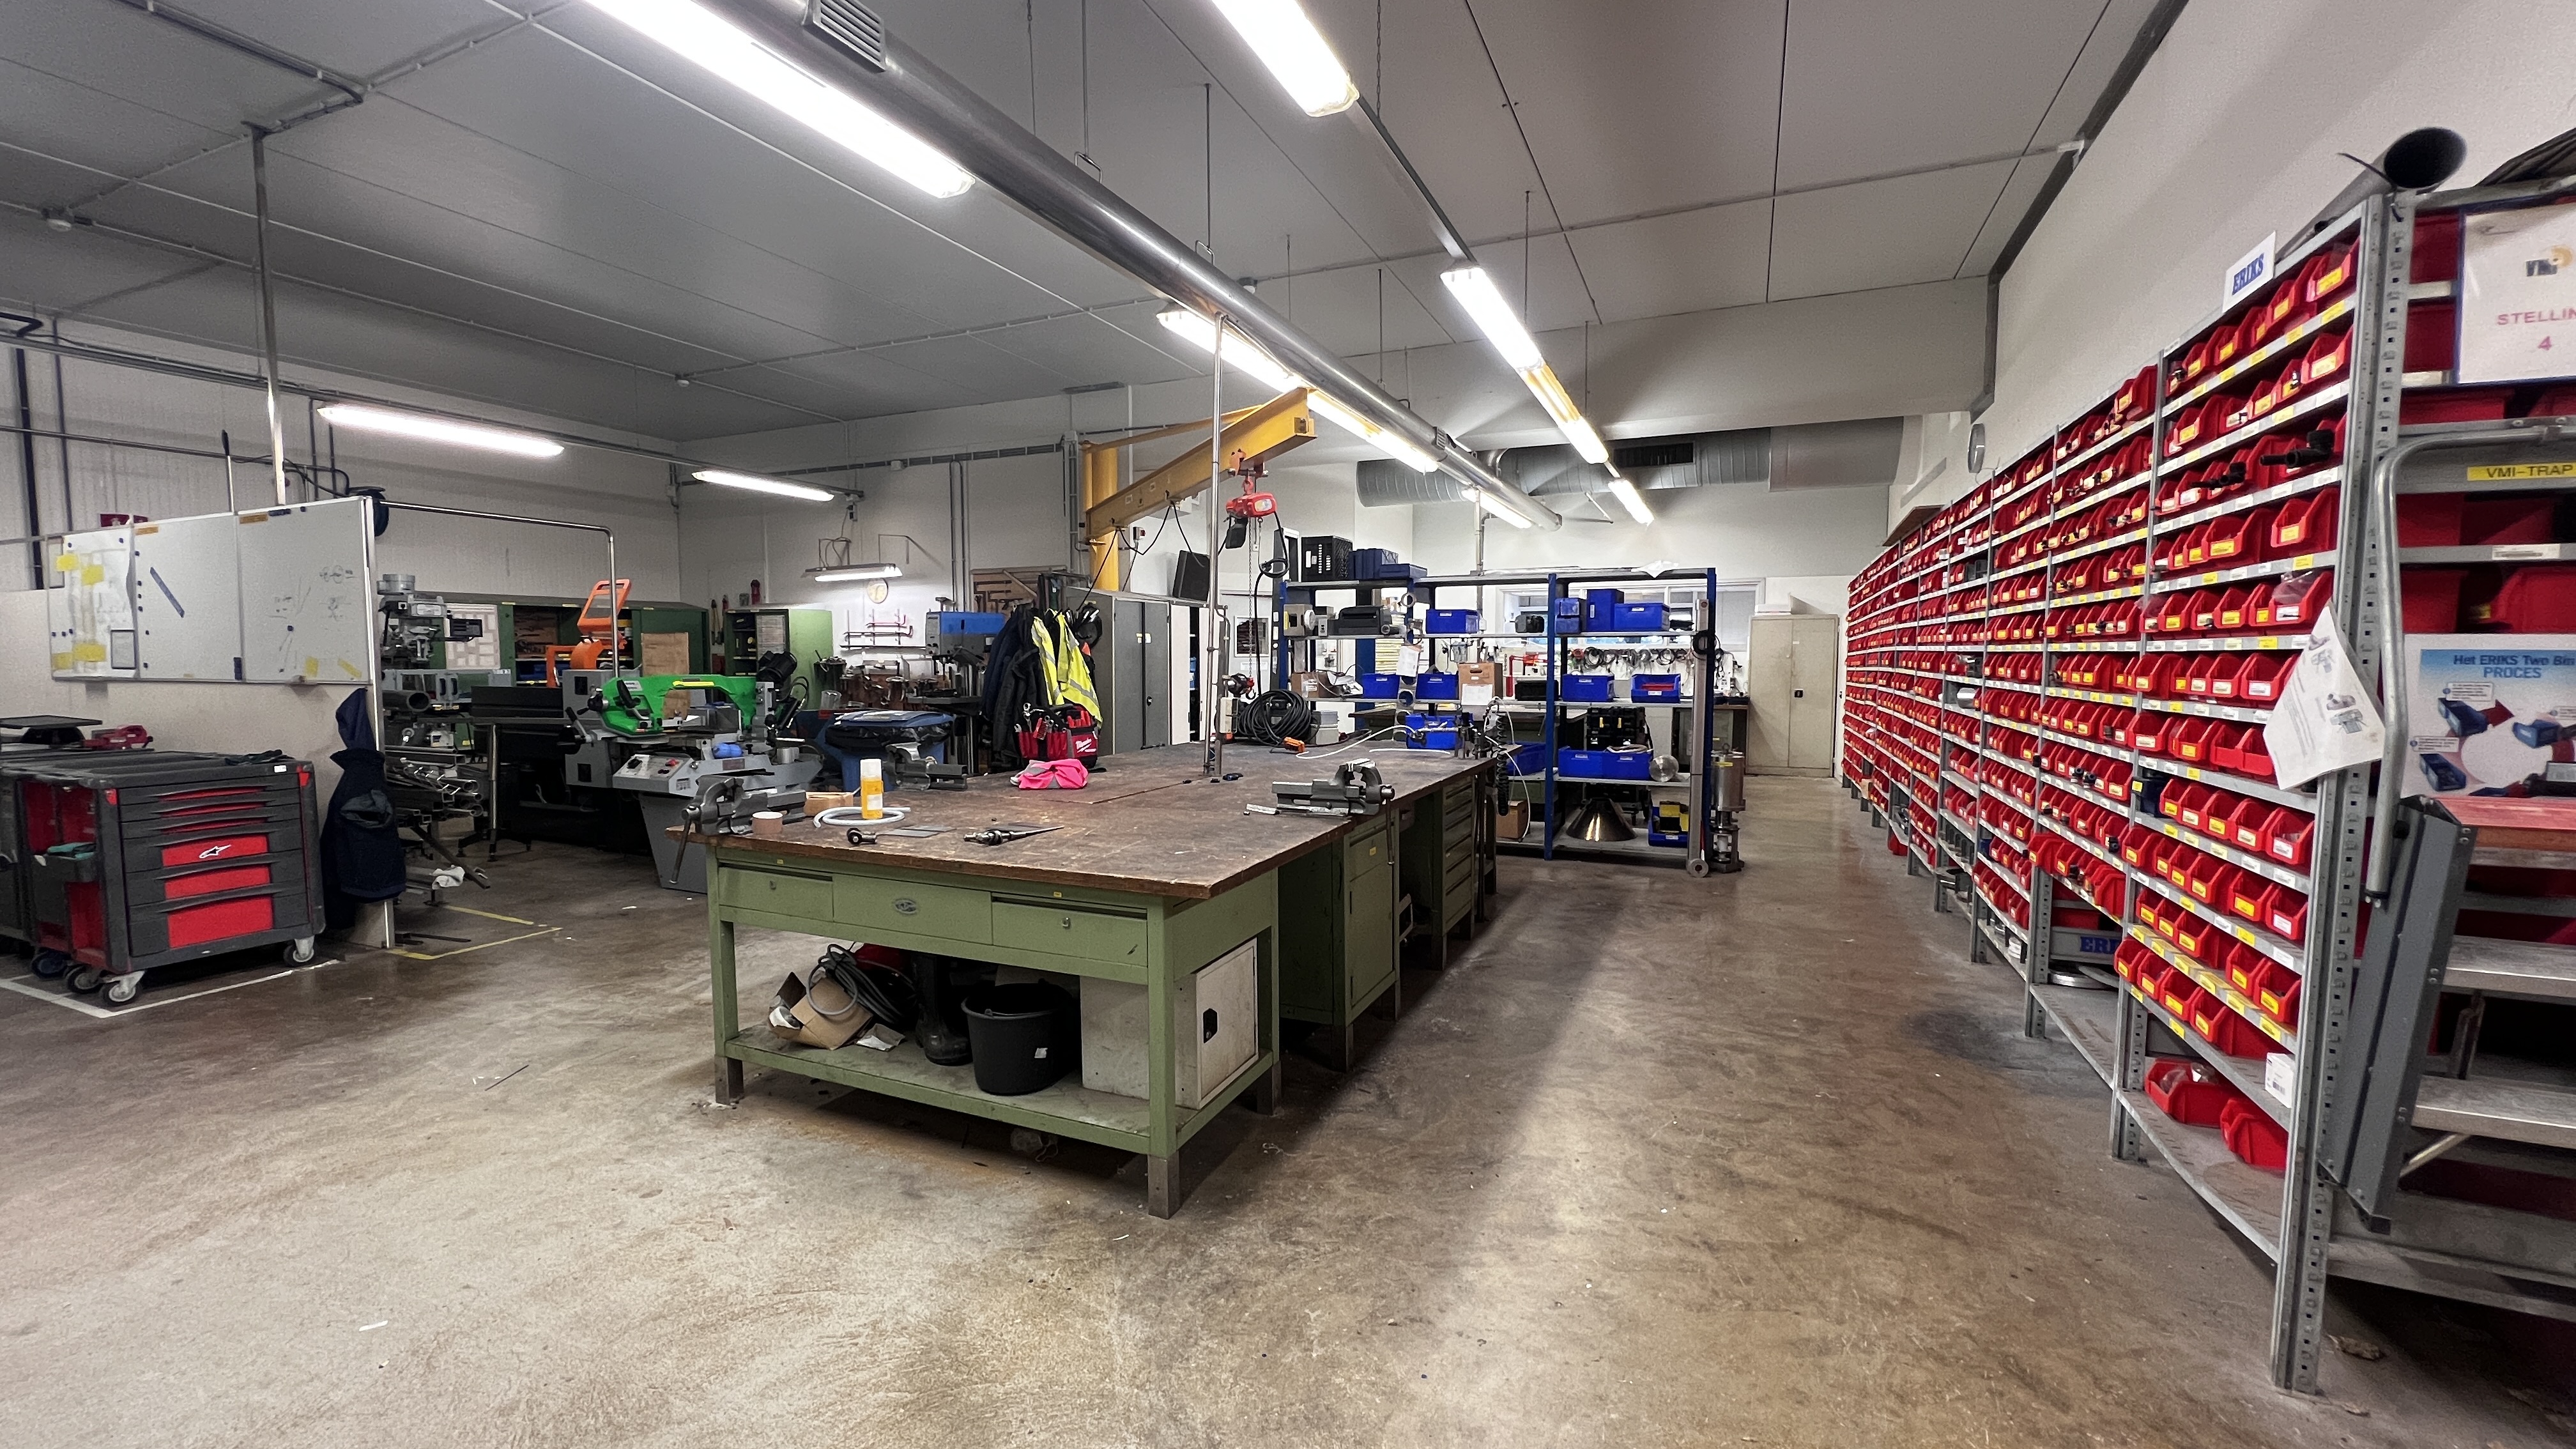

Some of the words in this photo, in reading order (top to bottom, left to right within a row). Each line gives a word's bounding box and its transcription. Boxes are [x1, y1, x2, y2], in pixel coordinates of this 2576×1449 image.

[2232, 252, 2265, 296] ERIKS
[2538, 335, 2552, 351] 4
[2487, 464, 2573, 478] VMI-TRAP
[2453, 655, 2476, 665] Het
[2480, 655, 2518, 665] ERIKS
[2522, 656, 2550, 666] Two
[2483, 668, 2542, 678] PROCES
